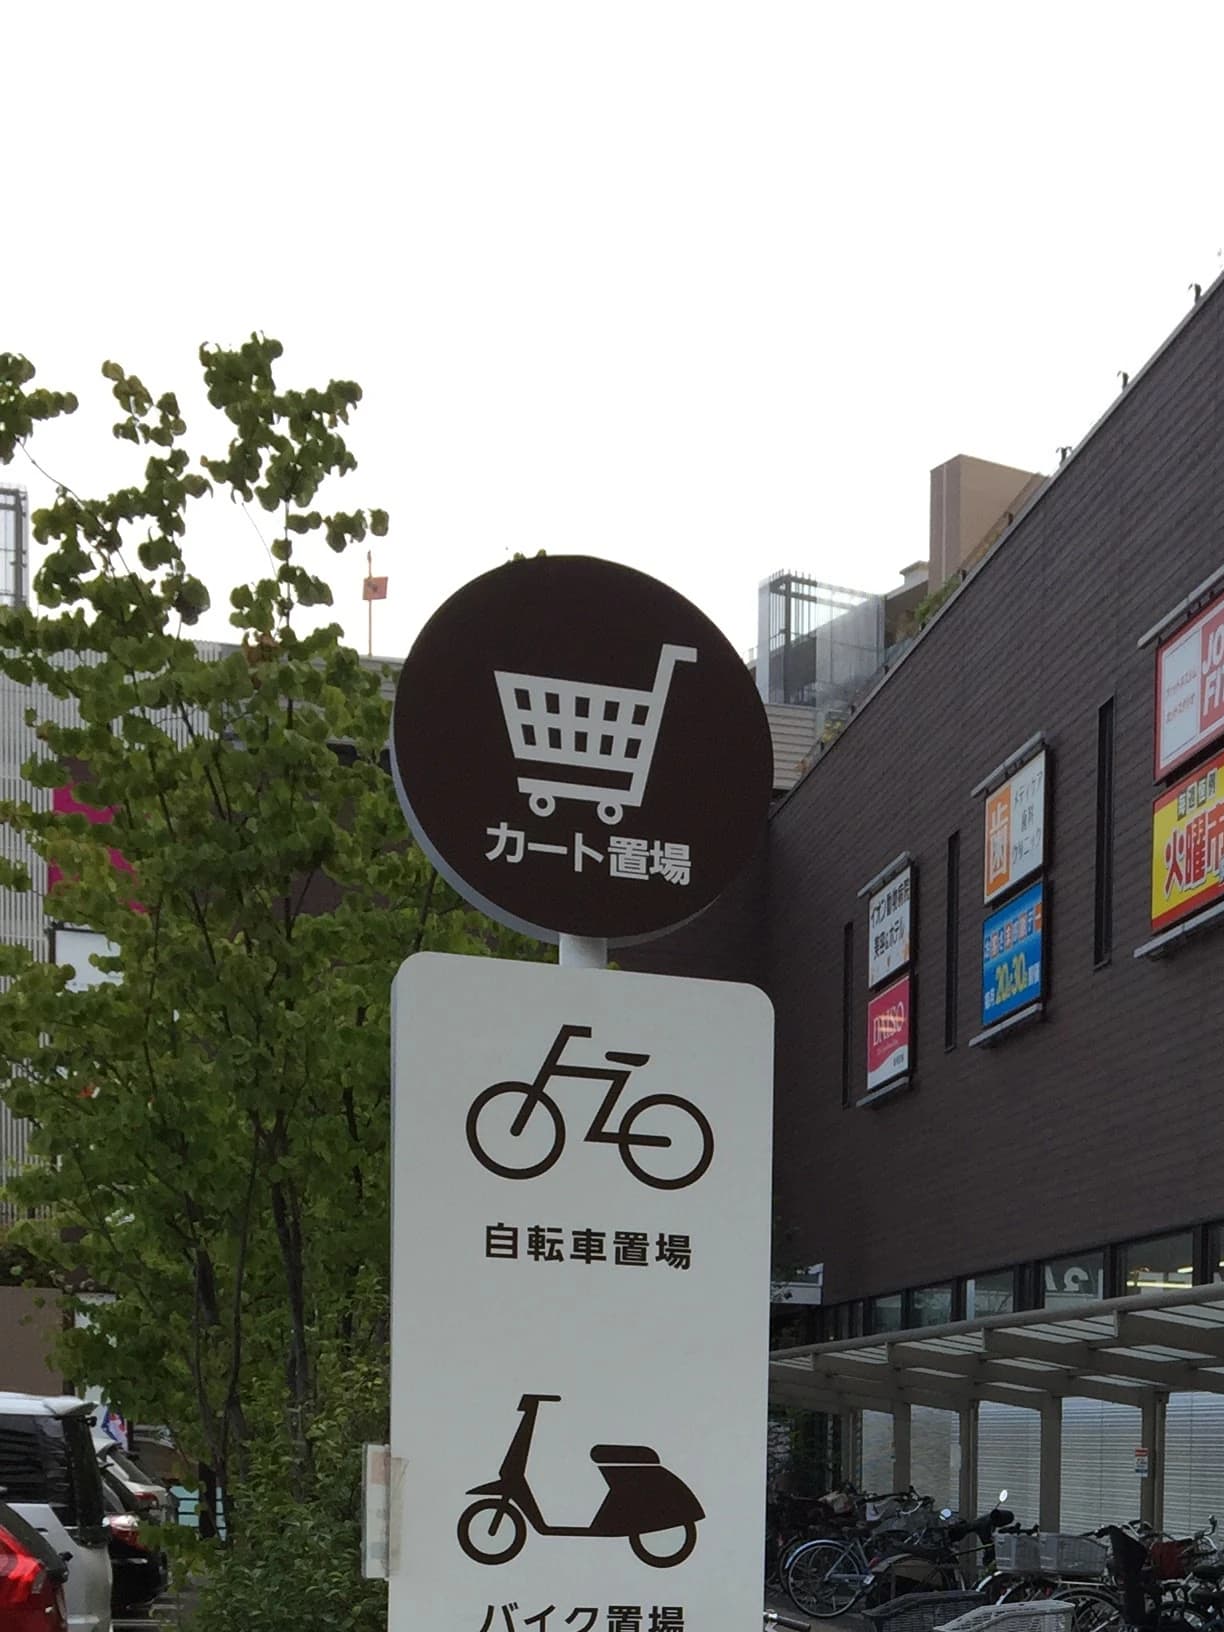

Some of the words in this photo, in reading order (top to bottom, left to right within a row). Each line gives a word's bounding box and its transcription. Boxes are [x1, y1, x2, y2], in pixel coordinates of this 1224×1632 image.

[485, 822, 692, 886] カート置場
[873, 1001, 906, 1046] DAISO
[484, 1222, 692, 1270] 自転車置場
